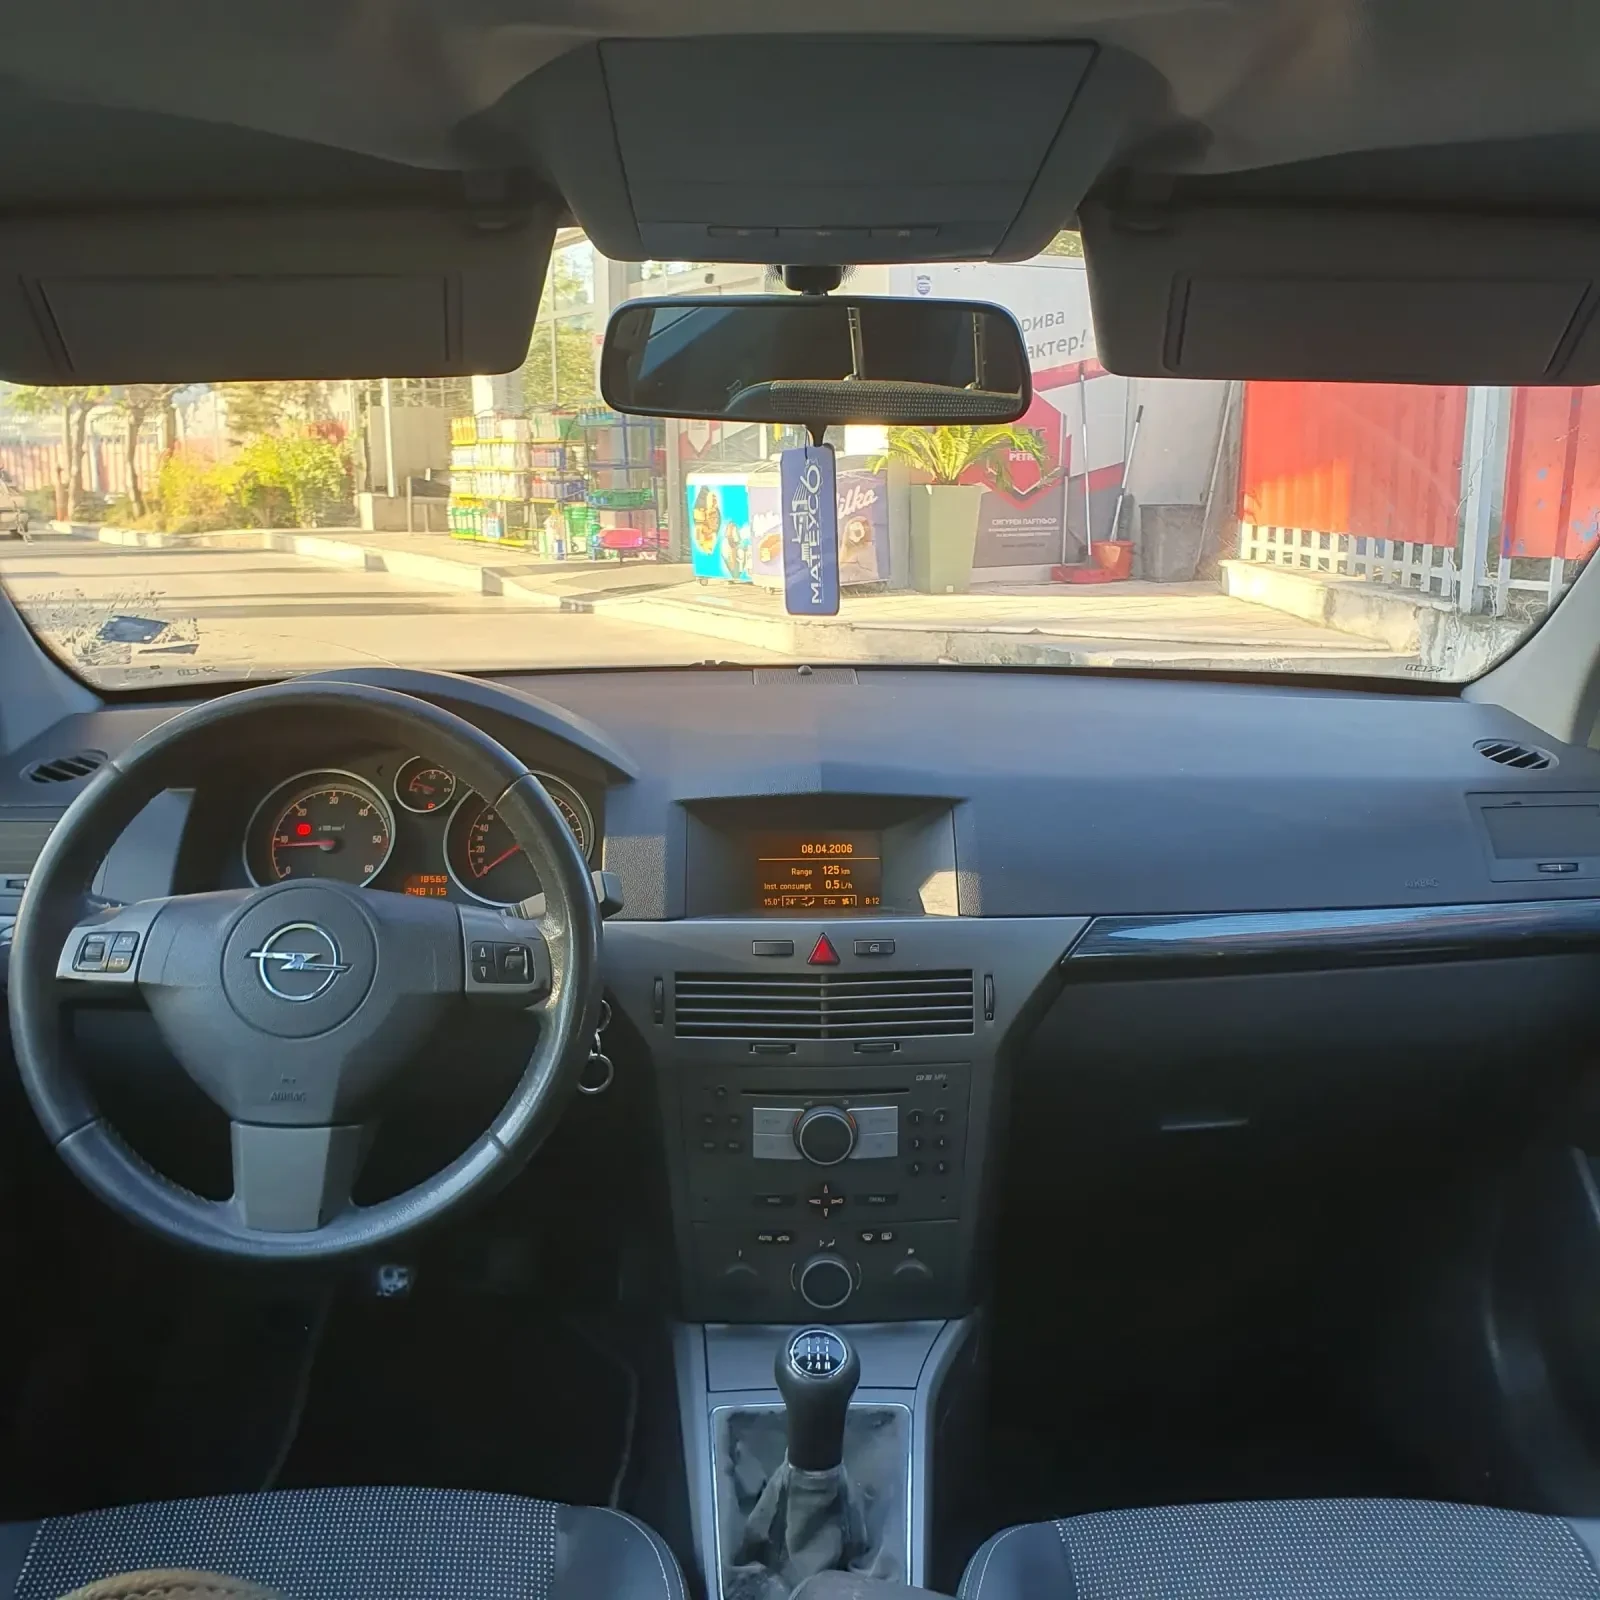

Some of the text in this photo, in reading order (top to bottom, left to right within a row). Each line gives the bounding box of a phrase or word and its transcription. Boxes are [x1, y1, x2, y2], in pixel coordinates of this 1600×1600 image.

[1021, 311, 1065, 332] рива
[1027, 329, 1087, 359] актер!
[1009, 452, 1036, 461] PETR
[329, 797, 339, 805] 30
[297, 808, 307, 817] 20
[358, 808, 368, 817] 40
[480, 824, 489, 832] 40
[372, 835, 382, 844] 50
[476, 845, 486, 853] 20
[801, 844, 853, 854] 08.04.2006
[364, 864, 374, 873] 60
[791, 868, 813, 877] Range
[822, 865, 840, 875] 125
[823, 897, 836, 905] Eco
[865, 897, 880, 905] 8:12
[806, 1361, 812, 1370] 2
